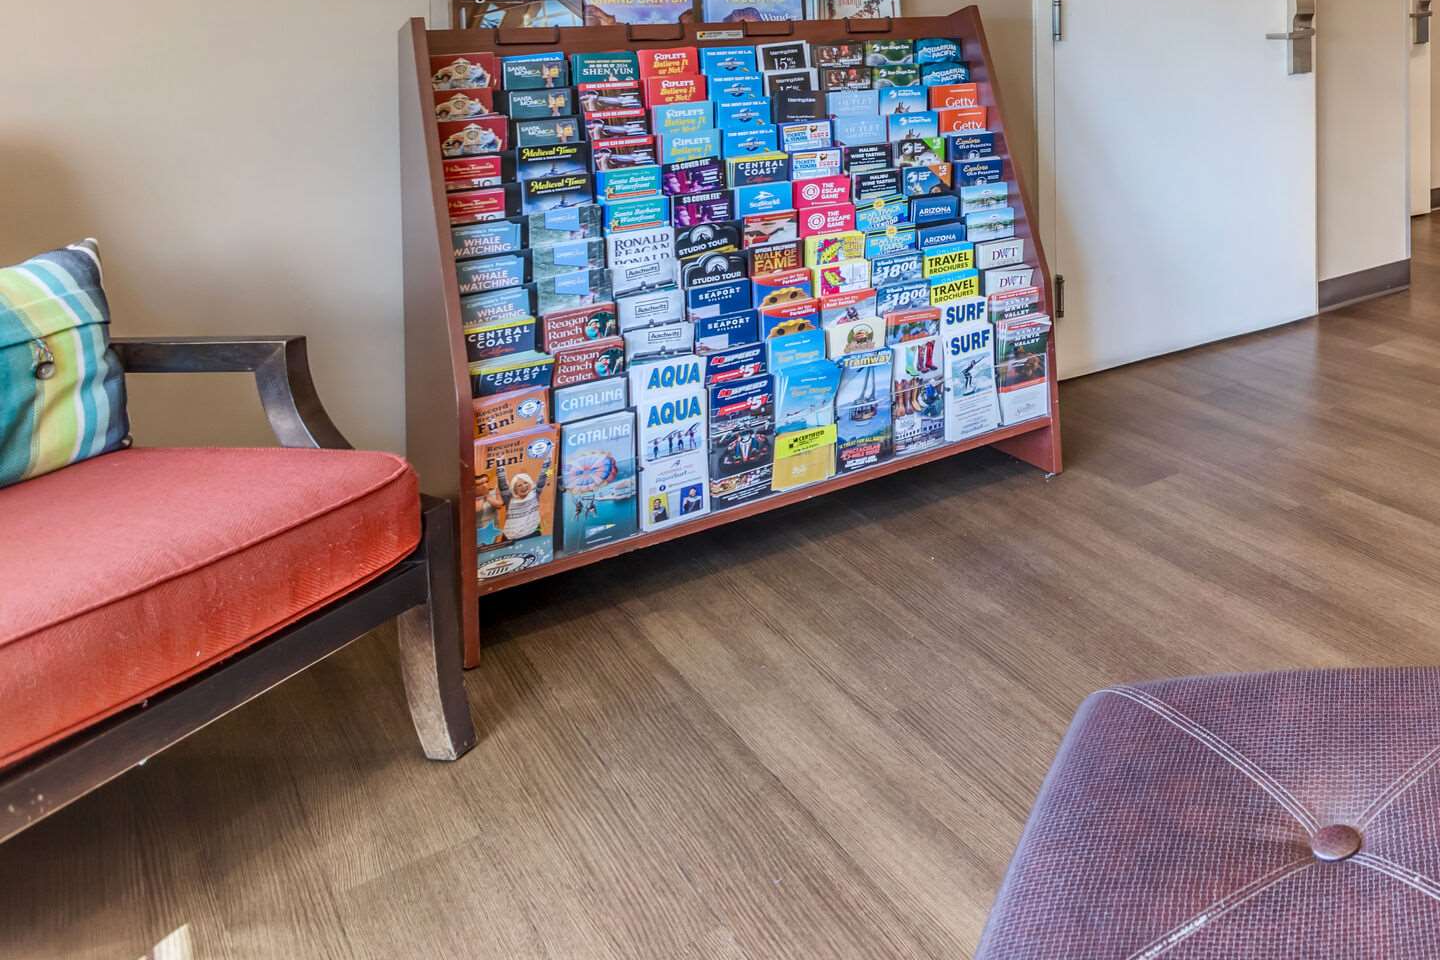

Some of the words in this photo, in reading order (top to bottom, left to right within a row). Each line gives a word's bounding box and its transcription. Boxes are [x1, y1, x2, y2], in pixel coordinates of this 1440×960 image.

[583, 68, 610, 76] SHEN
[945, 97, 976, 107] Getty
[953, 121, 983, 131] Getty
[522, 147, 556, 159] Medieval
[556, 146, 577, 155] Times
[738, 160, 783, 170] CENTRAL
[745, 167, 777, 176] COAST
[531, 180, 564, 193] Medieval
[564, 178, 587, 187] Times
[919, 206, 952, 214] ARIZONA
[464, 236, 501, 247] WHALE
[615, 233, 669, 251] RONALD
[924, 234, 956, 243] ARIZONA
[679, 244, 706, 256] STUDIO
[708, 238, 728, 248] TOUR
[754, 251, 781, 260] WALK
[784, 248, 797, 256] OF
[929, 252, 969, 268] TRAVEL
[993, 248, 1018, 260] DWT
[755, 257, 797, 274] FAME
[929, 262, 969, 275] BROCHURES
[472, 271, 508, 282] WHALE
[692, 276, 721, 285] STUDIO
[722, 272, 741, 280] TOUR
[999, 276, 1025, 288] DWT
[460, 277, 519, 293] WATCHING
[933, 279, 974, 296] TRAVEL
[698, 287, 741, 301] SEAPORT
[934, 290, 973, 304] BROCHURES
[476, 304, 514, 317] WHALE
[946, 301, 985, 325] SURF
[1004, 310, 1030, 319] VALLEY
[548, 316, 588, 330] Reagan
[707, 317, 750, 330] SEAPORT
[468, 326, 530, 342] CENTRAL
[548, 326, 583, 340] Ranch
[477, 335, 521, 349] COAST
[549, 337, 585, 350] Center
[951, 329, 990, 356] SURF
[560, 352, 599, 363] Reagan
[487, 365, 548, 382] CENTRAL
[558, 361, 593, 373] Ranch
[494, 373, 538, 386] COAST
[557, 373, 593, 384] Center
[647, 362, 700, 389] AQUA
[561, 388, 623, 411] CATALINA
[647, 396, 702, 428] AQUA
[477, 415, 514, 435] Fun!
[568, 424, 631, 446] CATALINA
[486, 454, 524, 470] Fun!
